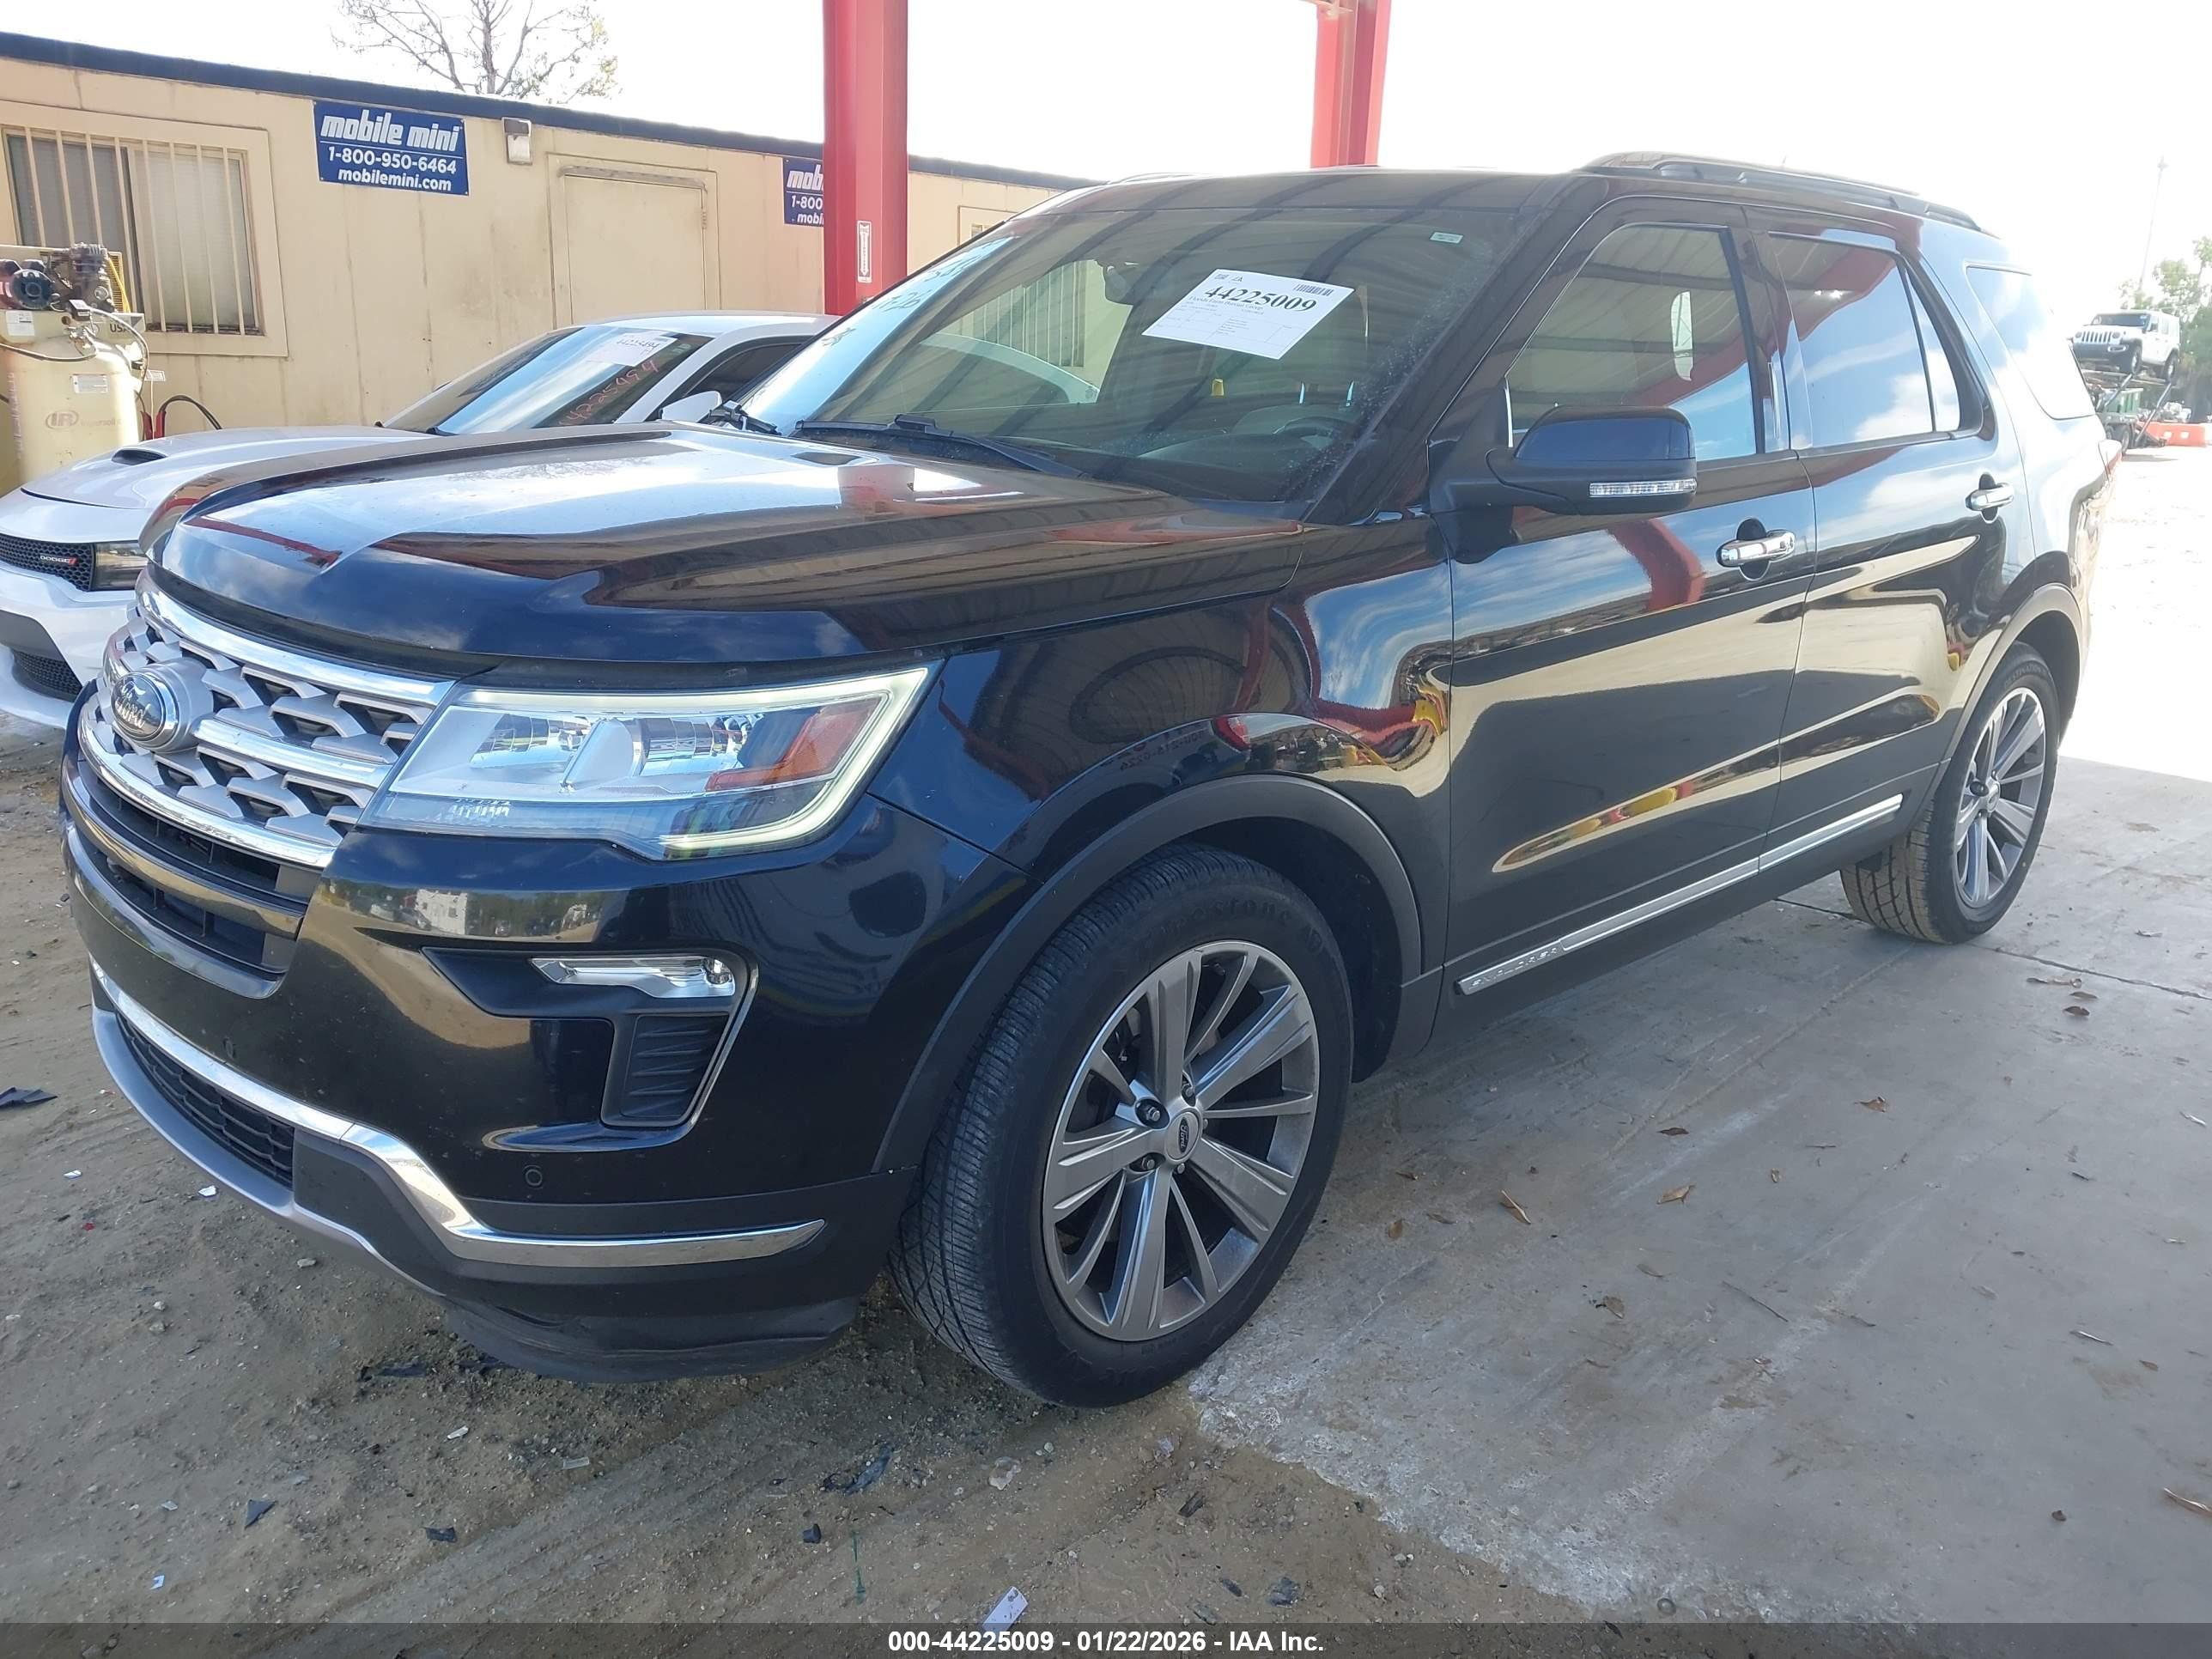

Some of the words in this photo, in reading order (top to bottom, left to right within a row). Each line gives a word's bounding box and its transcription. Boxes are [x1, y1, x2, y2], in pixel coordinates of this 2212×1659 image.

[320, 109, 404, 146] mobile
[406, 123, 460, 152] mini
[328, 146, 457, 174] 1-800-950-6464
[337, 168, 452, 191] mobilemini.com
[787, 164, 823, 191] mob
[1205, 286, 1317, 312] 44225009
[40, 555, 69, 563] DODGE
[114, 680, 152, 729] Ford
[1180, 1125, 1190, 1149] Ford
